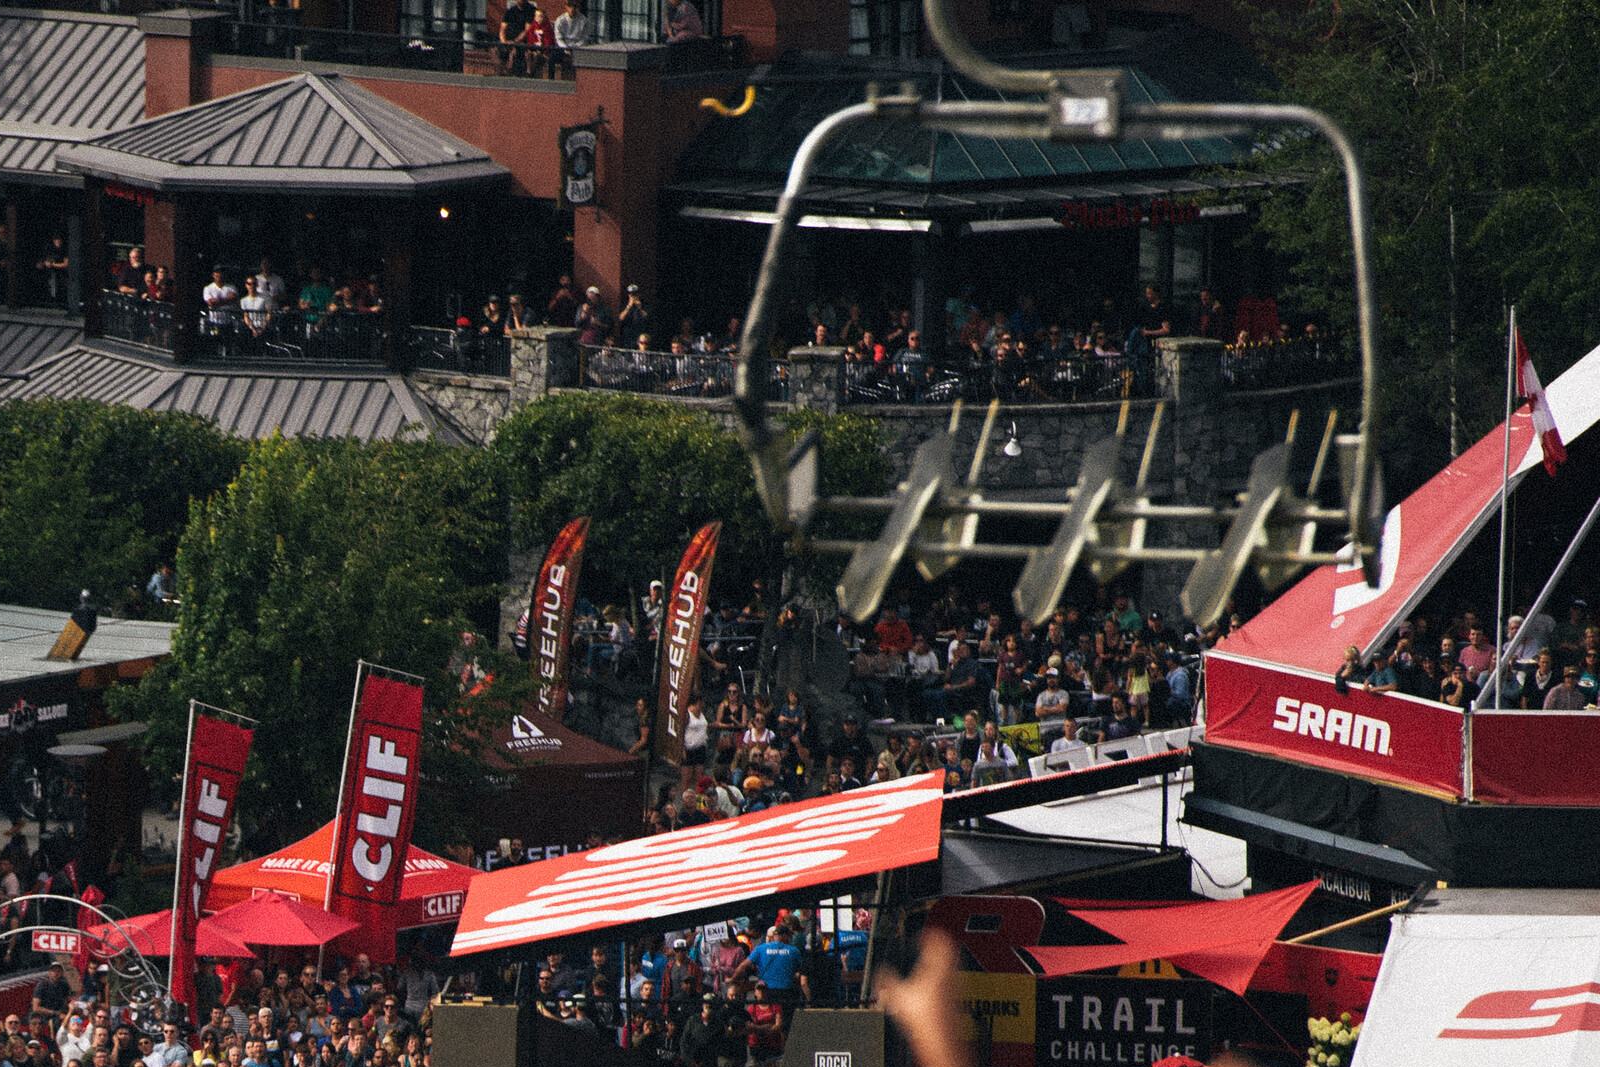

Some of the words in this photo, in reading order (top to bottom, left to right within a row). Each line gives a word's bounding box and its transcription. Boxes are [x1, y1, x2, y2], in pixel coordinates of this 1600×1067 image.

[667, 570, 699, 737] FREEHUB
[1272, 696, 1388, 756] SRAM
[506, 737, 563, 751] FREEHUB
[352, 735, 409, 883] CLIF
[261, 858, 303, 869] MAKE
[301, 859, 320, 871] IT
[412, 858, 449, 870] GOOD
[427, 896, 460, 917] CLIF
[707, 926, 725, 936] EXIT
[37, 934, 77, 951] CLIF
[1052, 994, 1196, 1035] TRAIL
